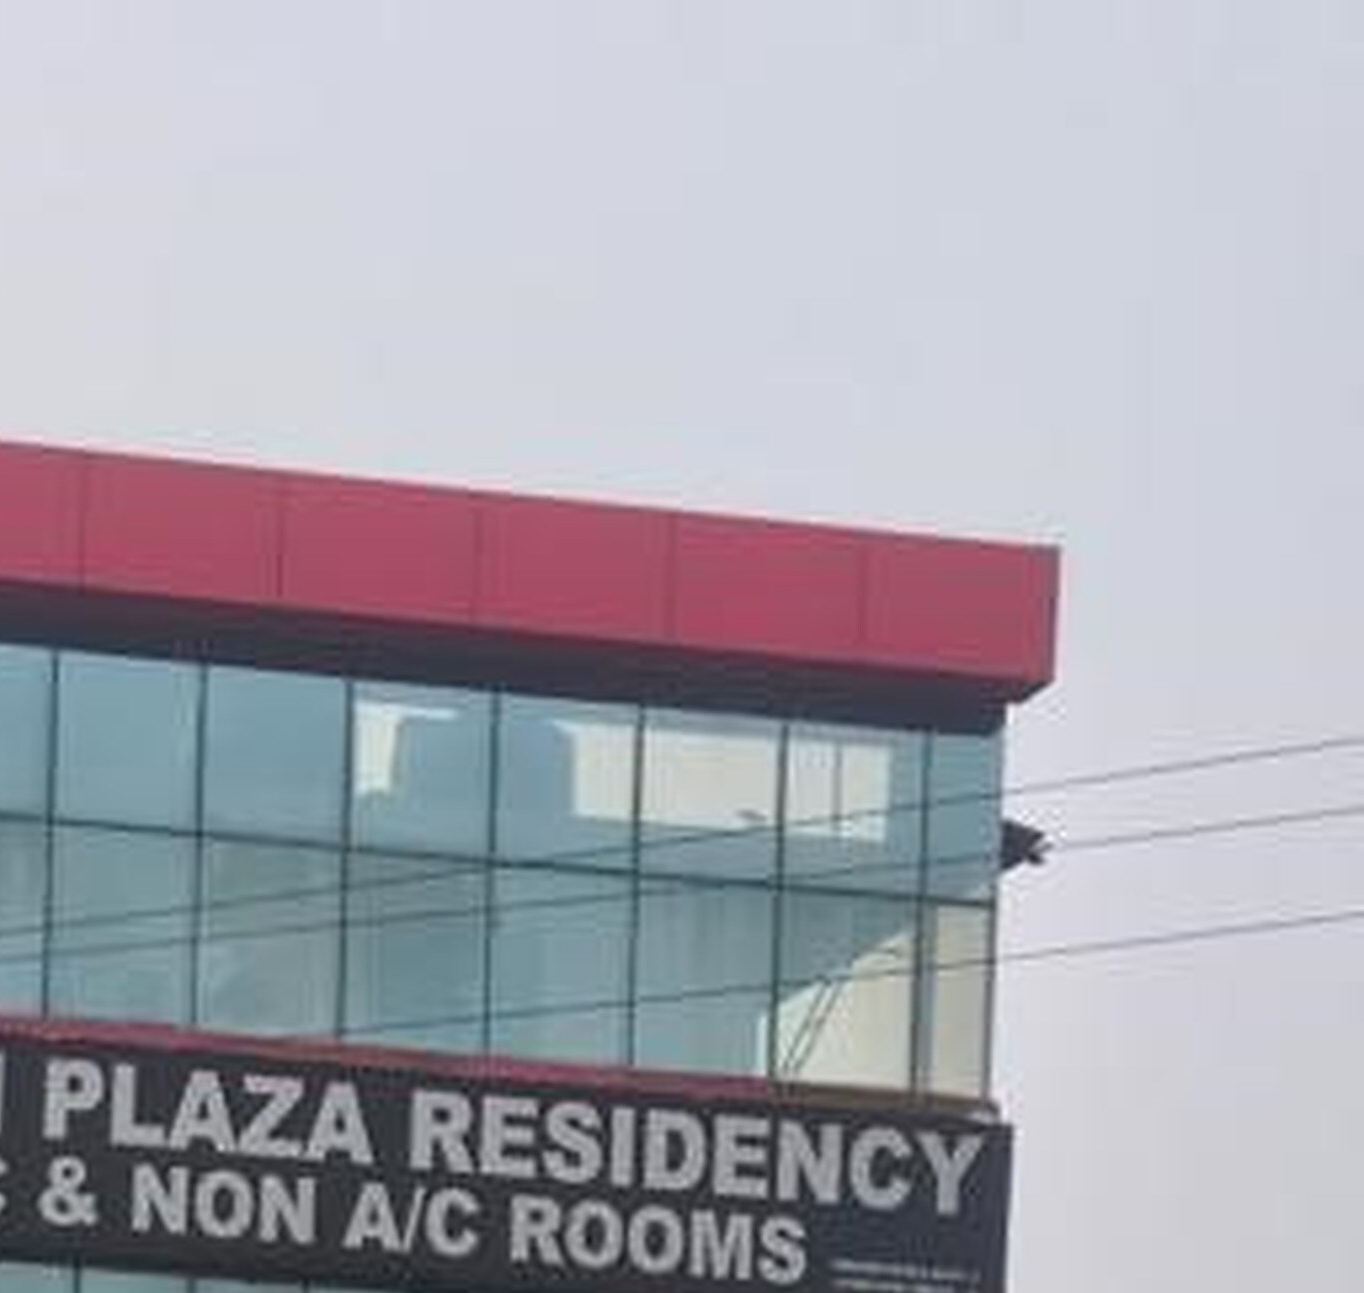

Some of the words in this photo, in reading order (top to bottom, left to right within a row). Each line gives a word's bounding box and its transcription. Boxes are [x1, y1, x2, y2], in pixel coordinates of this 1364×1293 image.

[42, 1055, 374, 1165] PLAZA
[408, 1086, 988, 1216] RESIDENCY
[37, 1155, 99, 1227] &
[130, 1163, 317, 1246] NON
[341, 1181, 482, 1259] A/C
[508, 1193, 809, 1286] ROOMS
